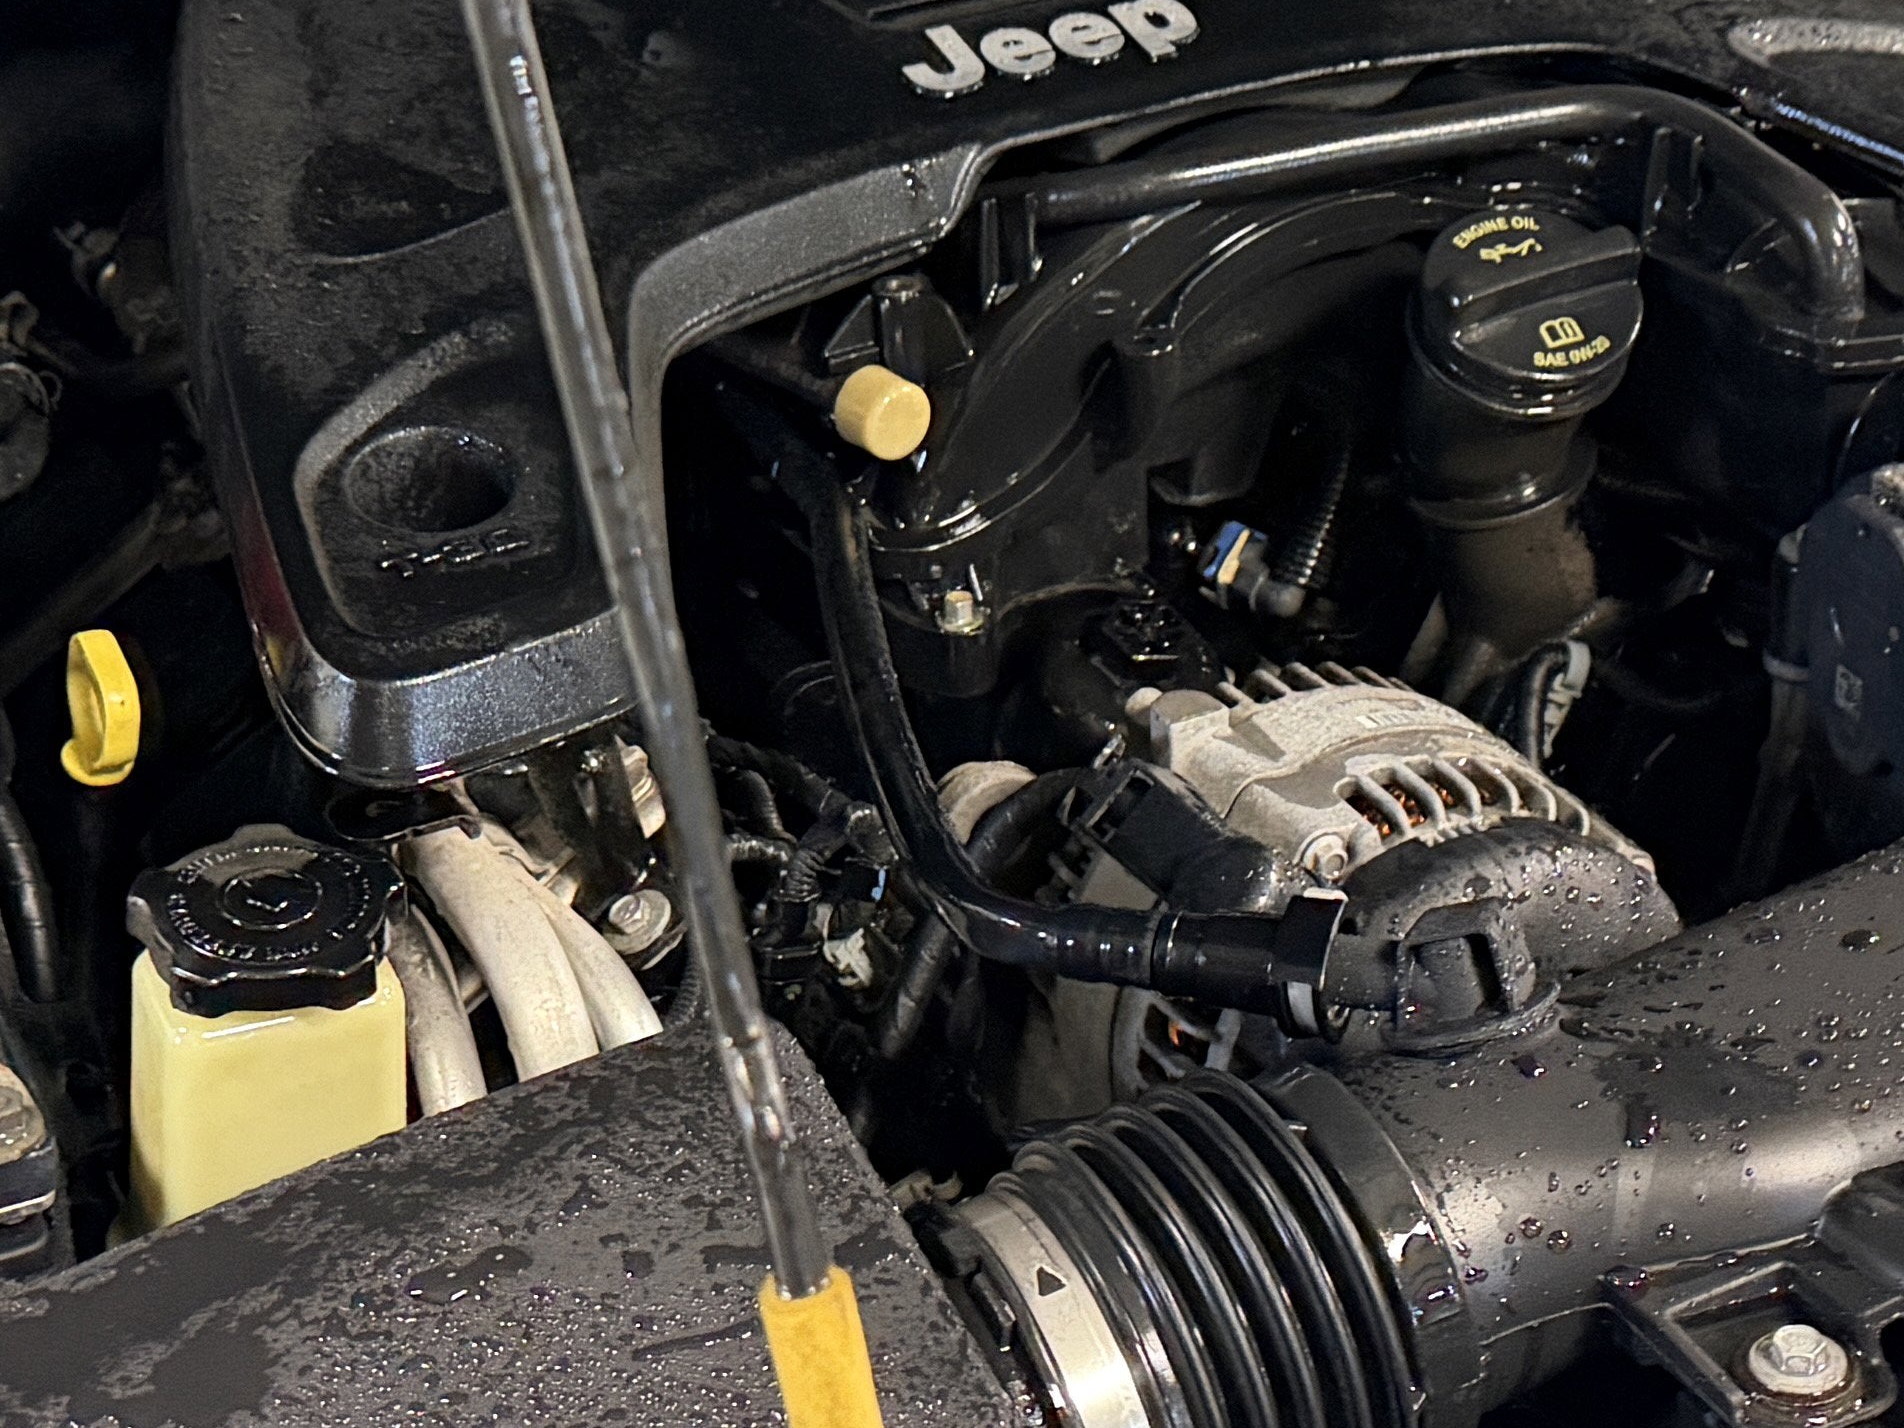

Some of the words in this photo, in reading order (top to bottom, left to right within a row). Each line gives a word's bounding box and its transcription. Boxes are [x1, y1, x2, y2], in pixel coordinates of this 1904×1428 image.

[1453, 217, 1509, 249] ENGINE
[1510, 215, 1540, 231] OIL
[1533, 351, 1569, 368] SAE
